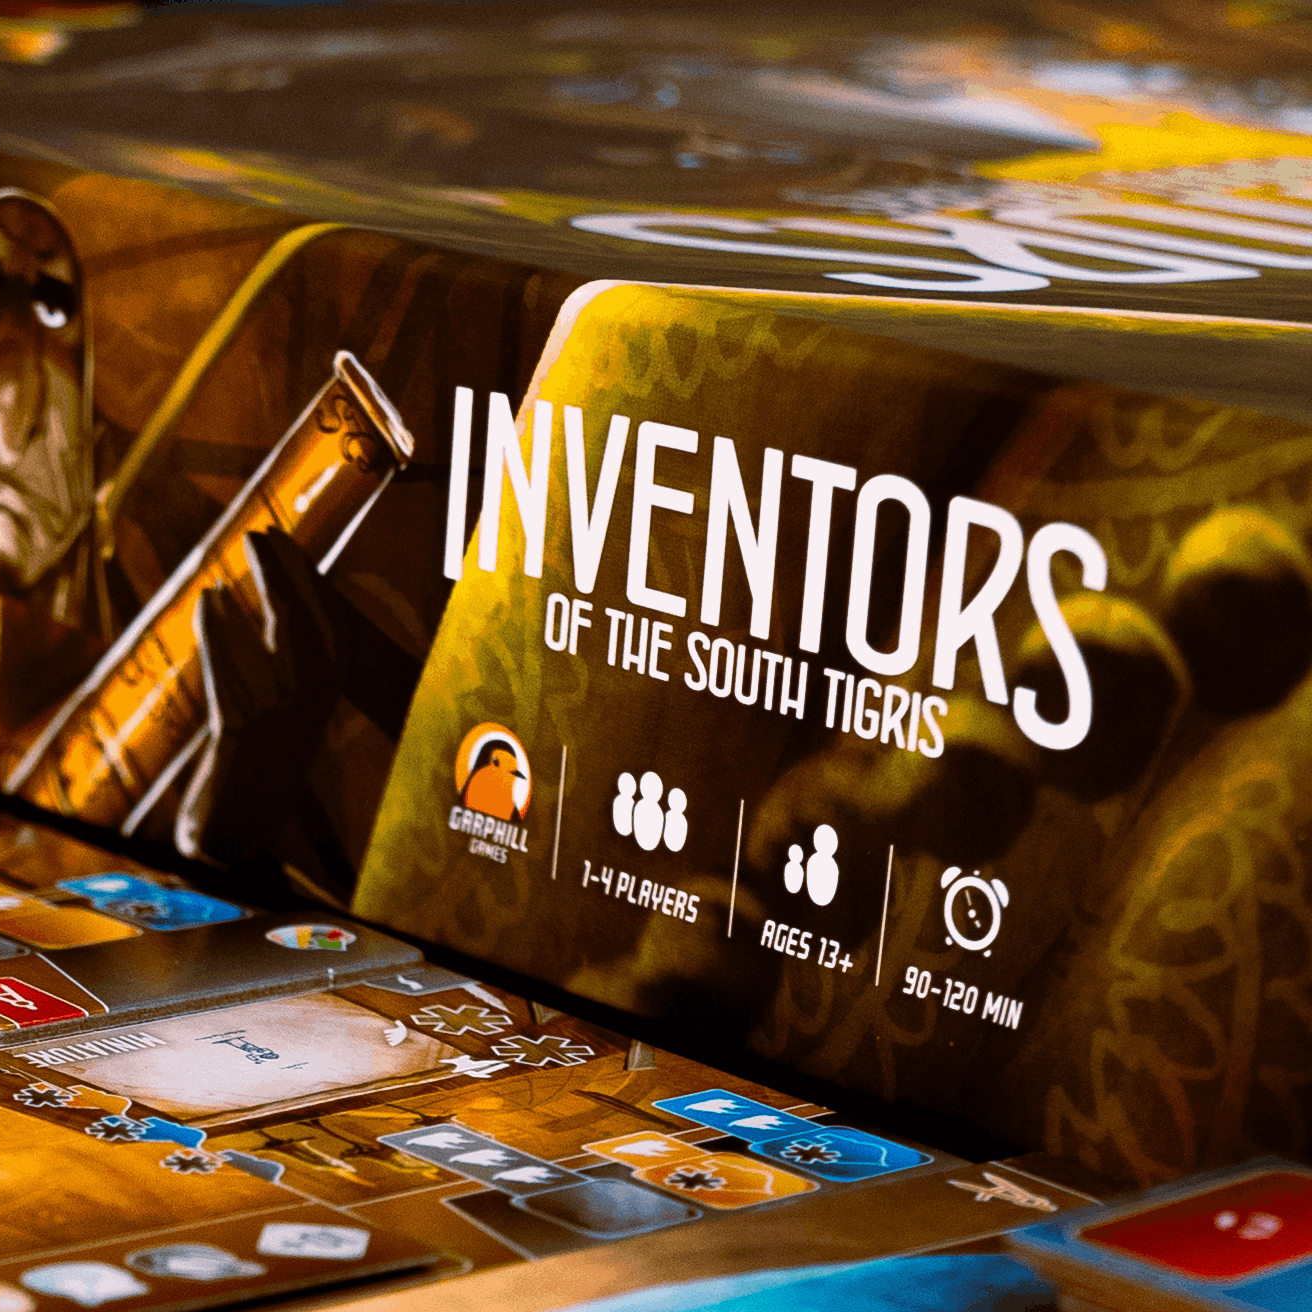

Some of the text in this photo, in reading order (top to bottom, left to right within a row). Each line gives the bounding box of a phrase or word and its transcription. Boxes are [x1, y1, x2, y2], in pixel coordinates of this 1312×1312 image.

[443, 385, 1108, 751] INVENTORS
[544, 592, 949, 759] OF THE SOUTH TIGRIS
[448, 804, 529, 853] GARPHILL
[468, 838, 509, 864] GAMES
[582, 859, 700, 924] 1-4 PLAYERS
[760, 919, 854, 974] AGES 13+
[902, 965, 1024, 1030] 90-120 MIN
[13, 1031, 167, 1068] MINIATURE
